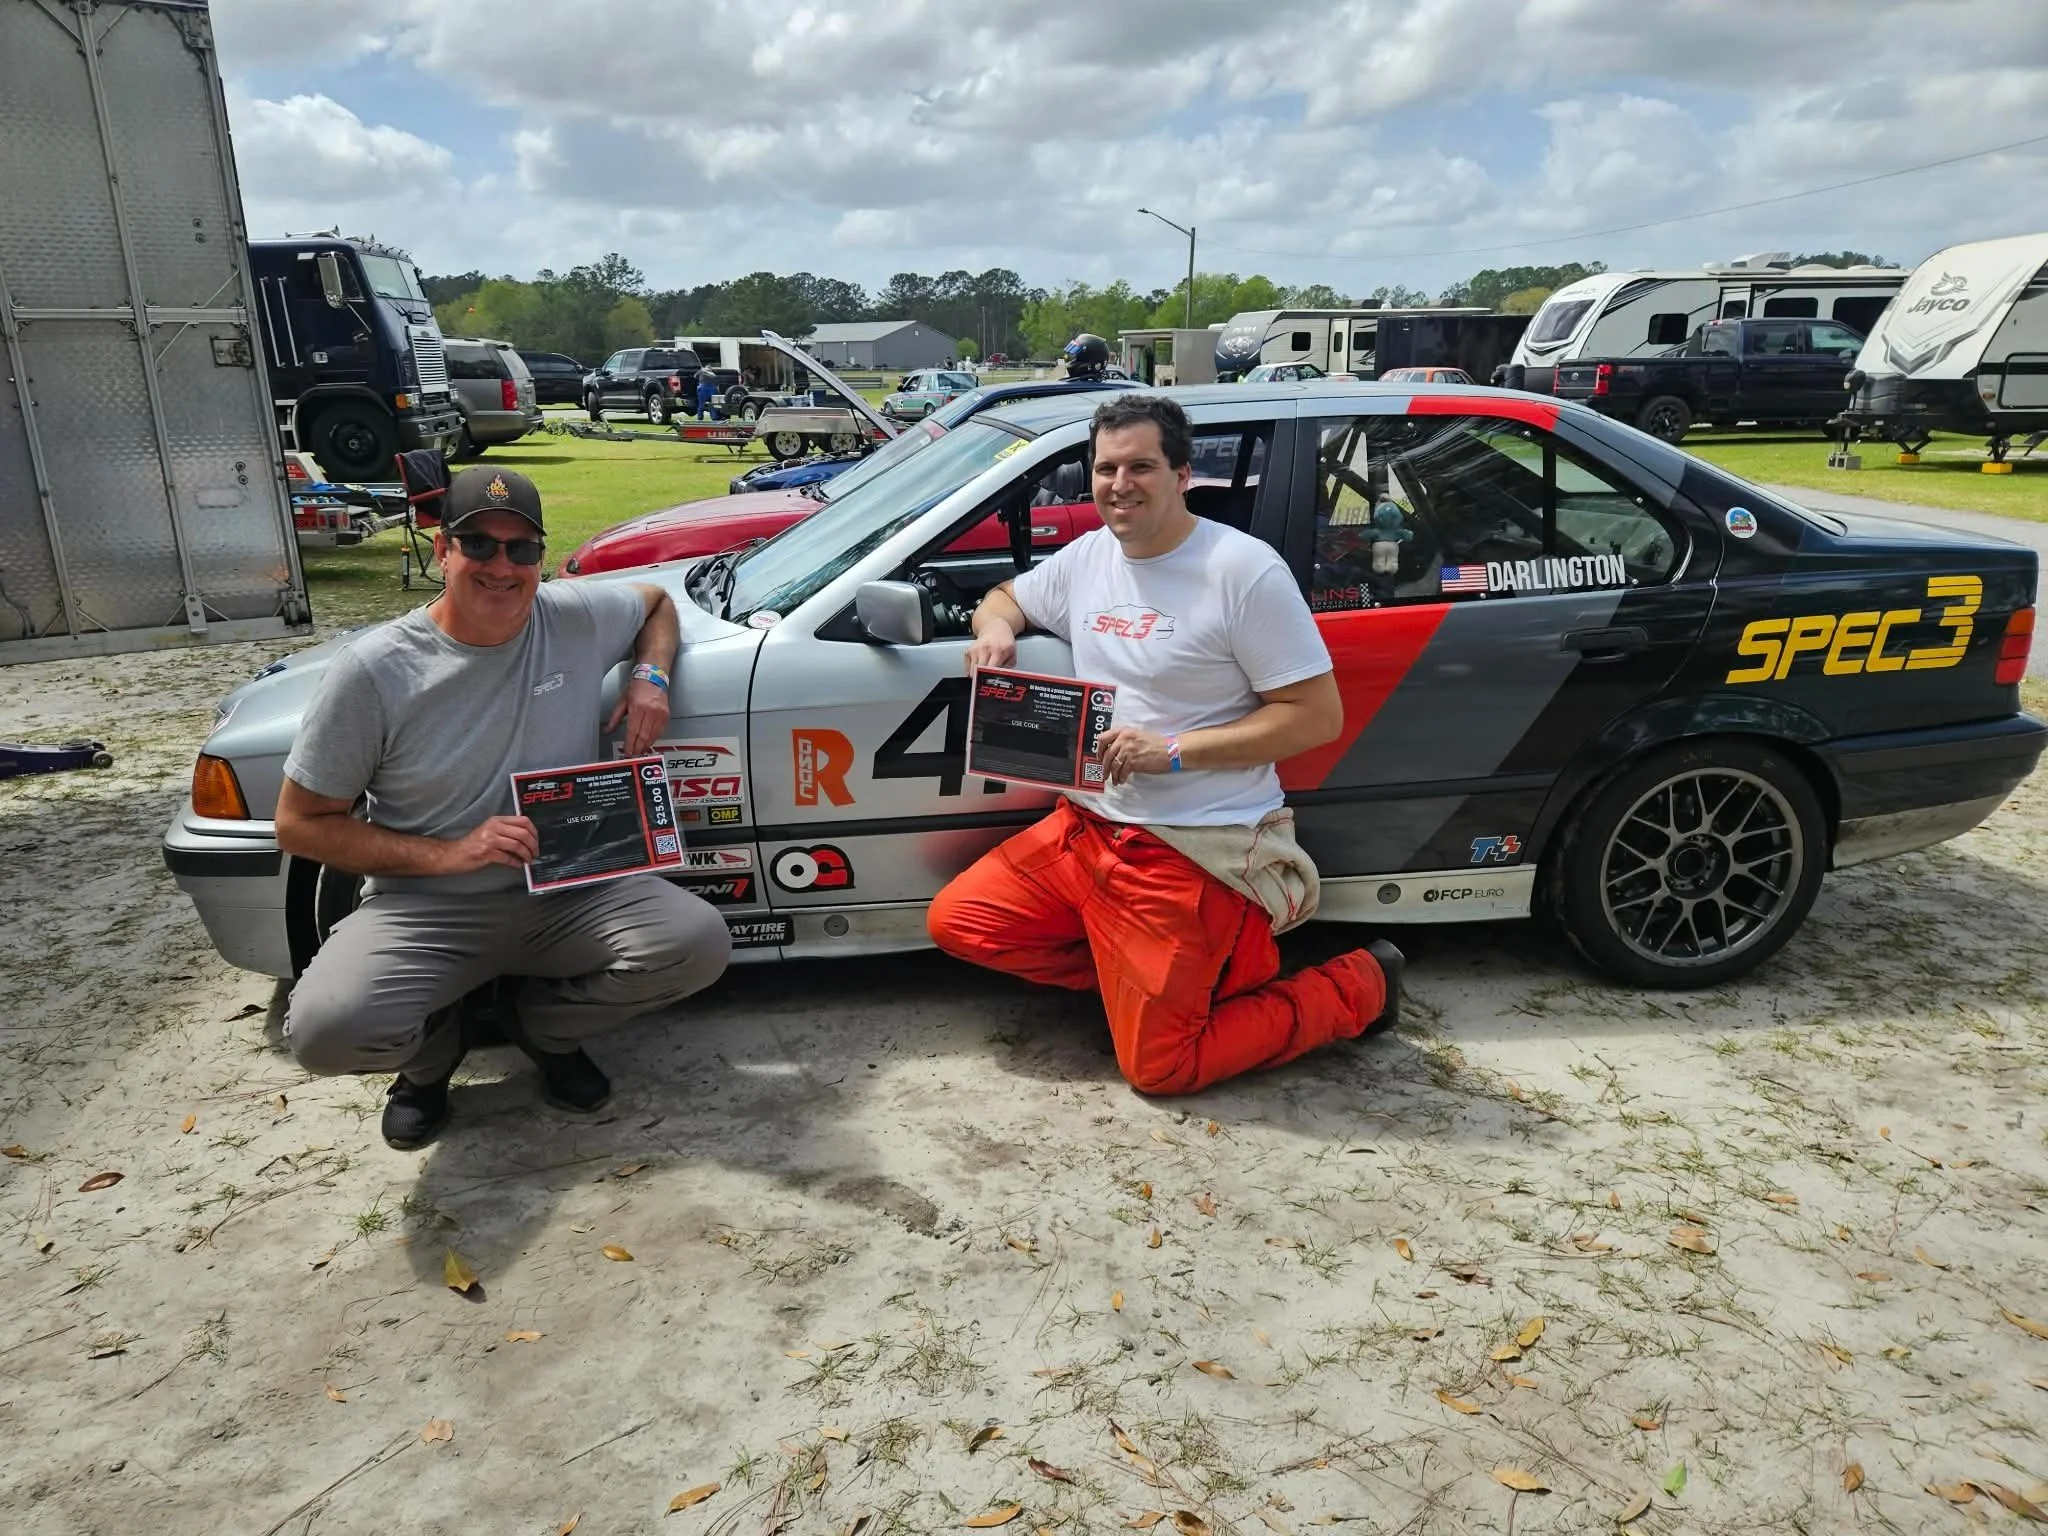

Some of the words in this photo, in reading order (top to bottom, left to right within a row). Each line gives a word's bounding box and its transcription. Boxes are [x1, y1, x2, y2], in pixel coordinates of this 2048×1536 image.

[1906, 296, 1971, 315] Jayco
[1487, 554, 1626, 592] DARLINGTON
[1091, 613, 1160, 640] SPEC3
[1725, 575, 1984, 684] SPEC3
[978, 684, 1027, 703] SPEC3
[1011, 720, 1023, 728] USE
[1023, 721, 1040, 729] CODE
[666, 753, 718, 768] SPEC3
[791, 729, 857, 806] R
[522, 782, 575, 805] SPEC3
[652, 787, 668, 826] $25.00
[711, 810, 739, 820] OMP
[566, 816, 580, 824] USE
[1440, 888, 1473, 901] FCP
[1474, 888, 1505, 899] EURO
[729, 922, 787, 935] AYTIRE
